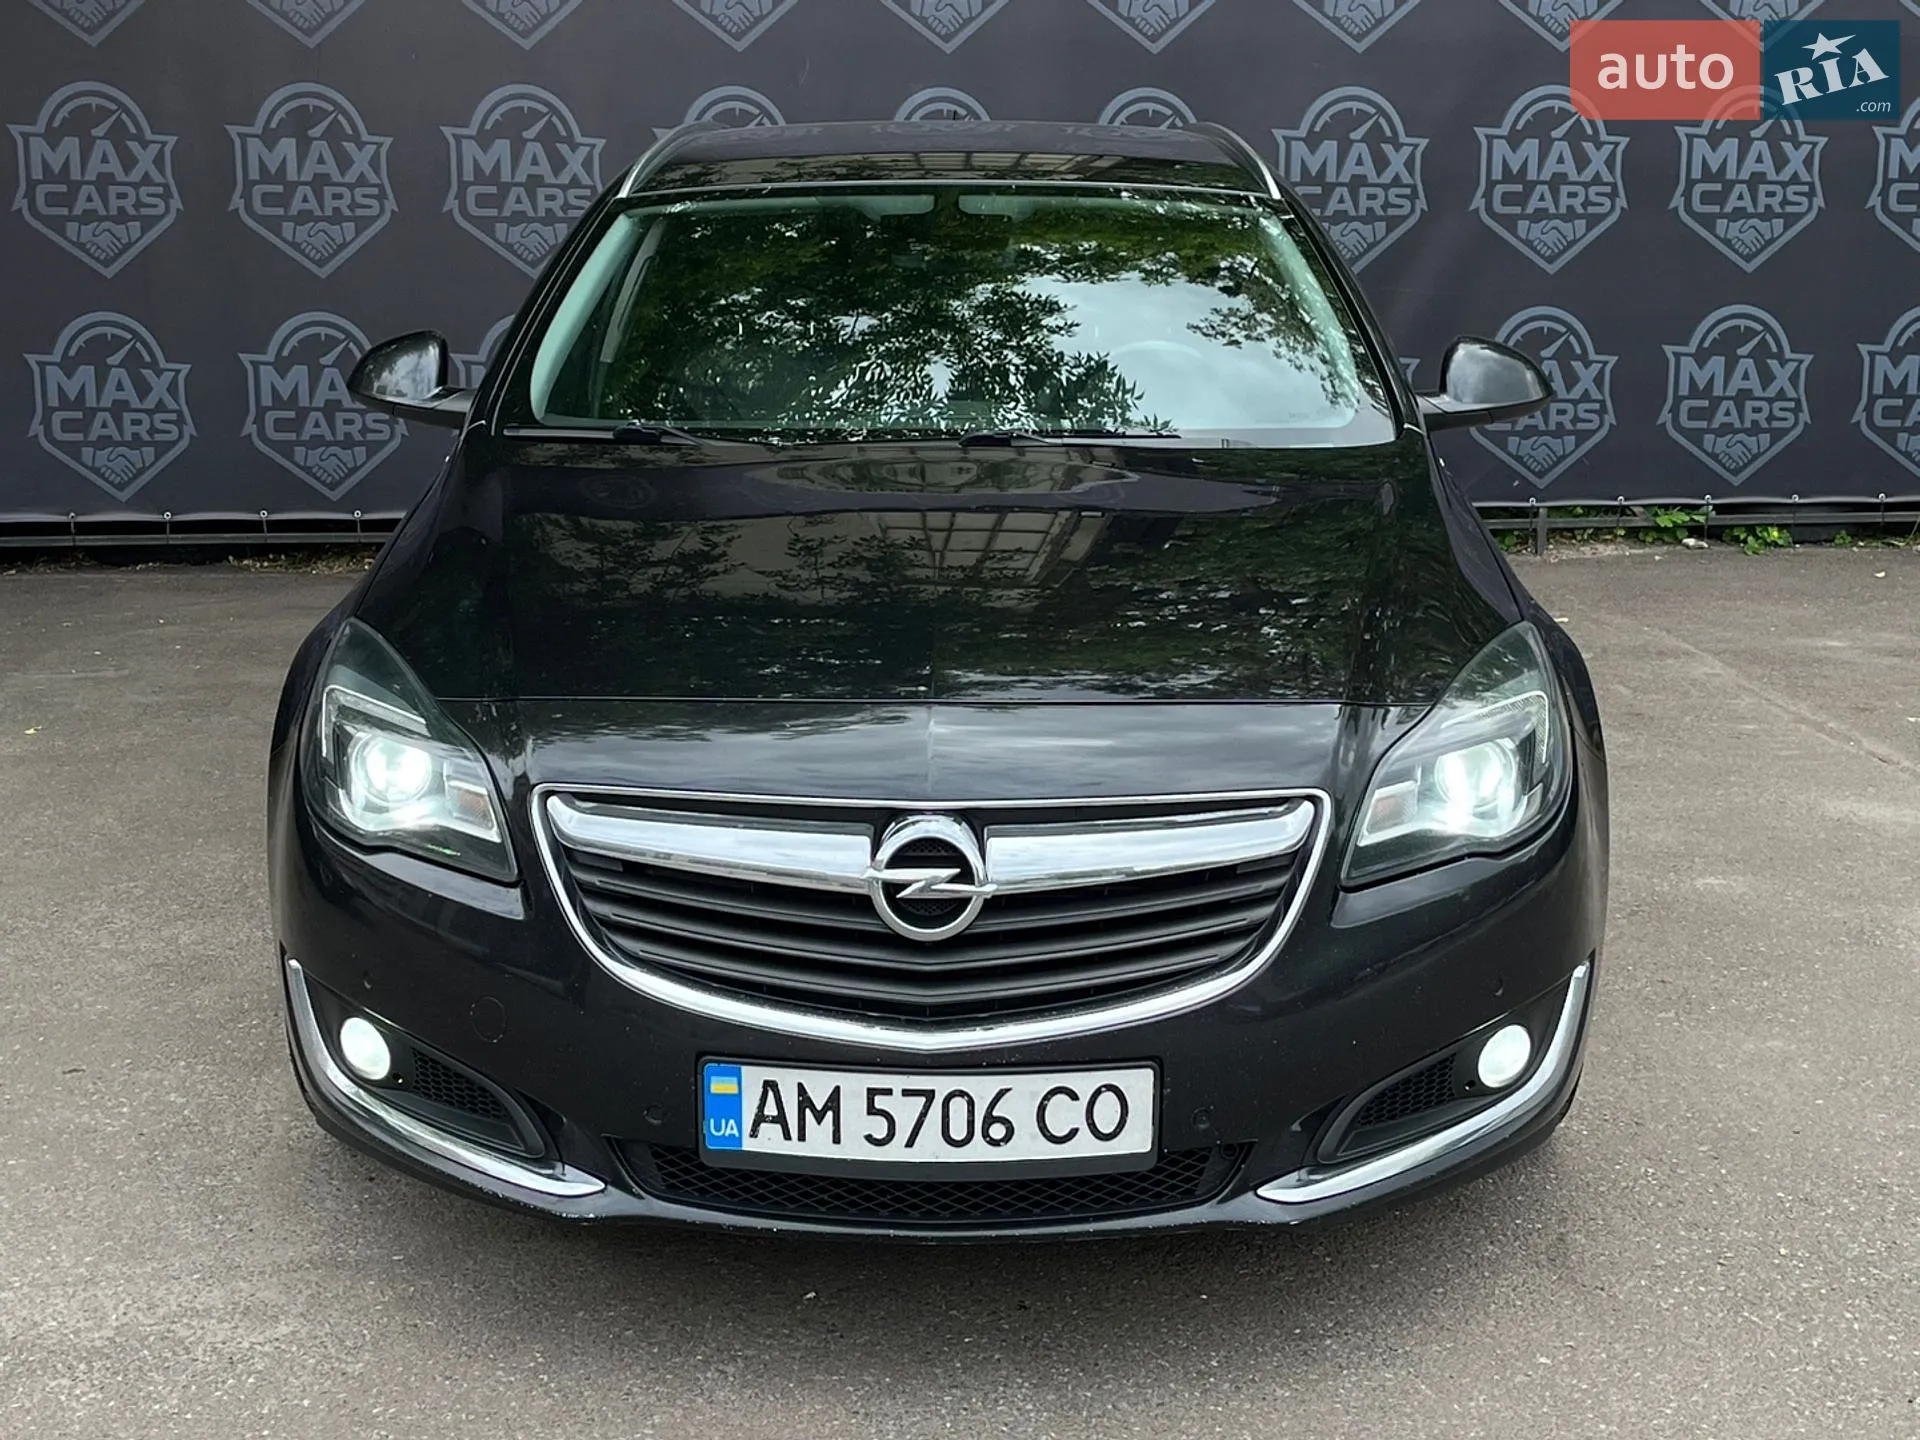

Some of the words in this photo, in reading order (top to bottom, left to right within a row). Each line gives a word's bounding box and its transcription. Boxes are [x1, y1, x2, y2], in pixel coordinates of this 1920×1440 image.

[30, 137, 165, 183] MAX
[247, 138, 381, 183] MAX
[461, 138, 594, 185] MAX
[1290, 139, 1415, 184] MAX
[1492, 138, 1615, 182] MAX
[1691, 138, 1814, 182] MAX
[36, 185, 165, 216] CARS
[253, 186, 380, 216] CARS
[466, 185, 592, 217] CARS
[1493, 184, 1612, 214] CARS
[1692, 183, 1811, 213] CARS
[45, 365, 179, 409] MAX
[259, 365, 366, 408] MA
[1541, 359, 1604, 400] AX
[1678, 355, 1799, 398] MAX
[53, 411, 179, 440] CARS
[264, 410, 392, 441] CARS
[1679, 400, 1796, 429] CARS
[709, 1120, 740, 1138] UA
[749, 1079, 842, 1144] AM
[863, 1087, 1015, 1149] 5706
[1035, 1082, 1130, 1145] CO
